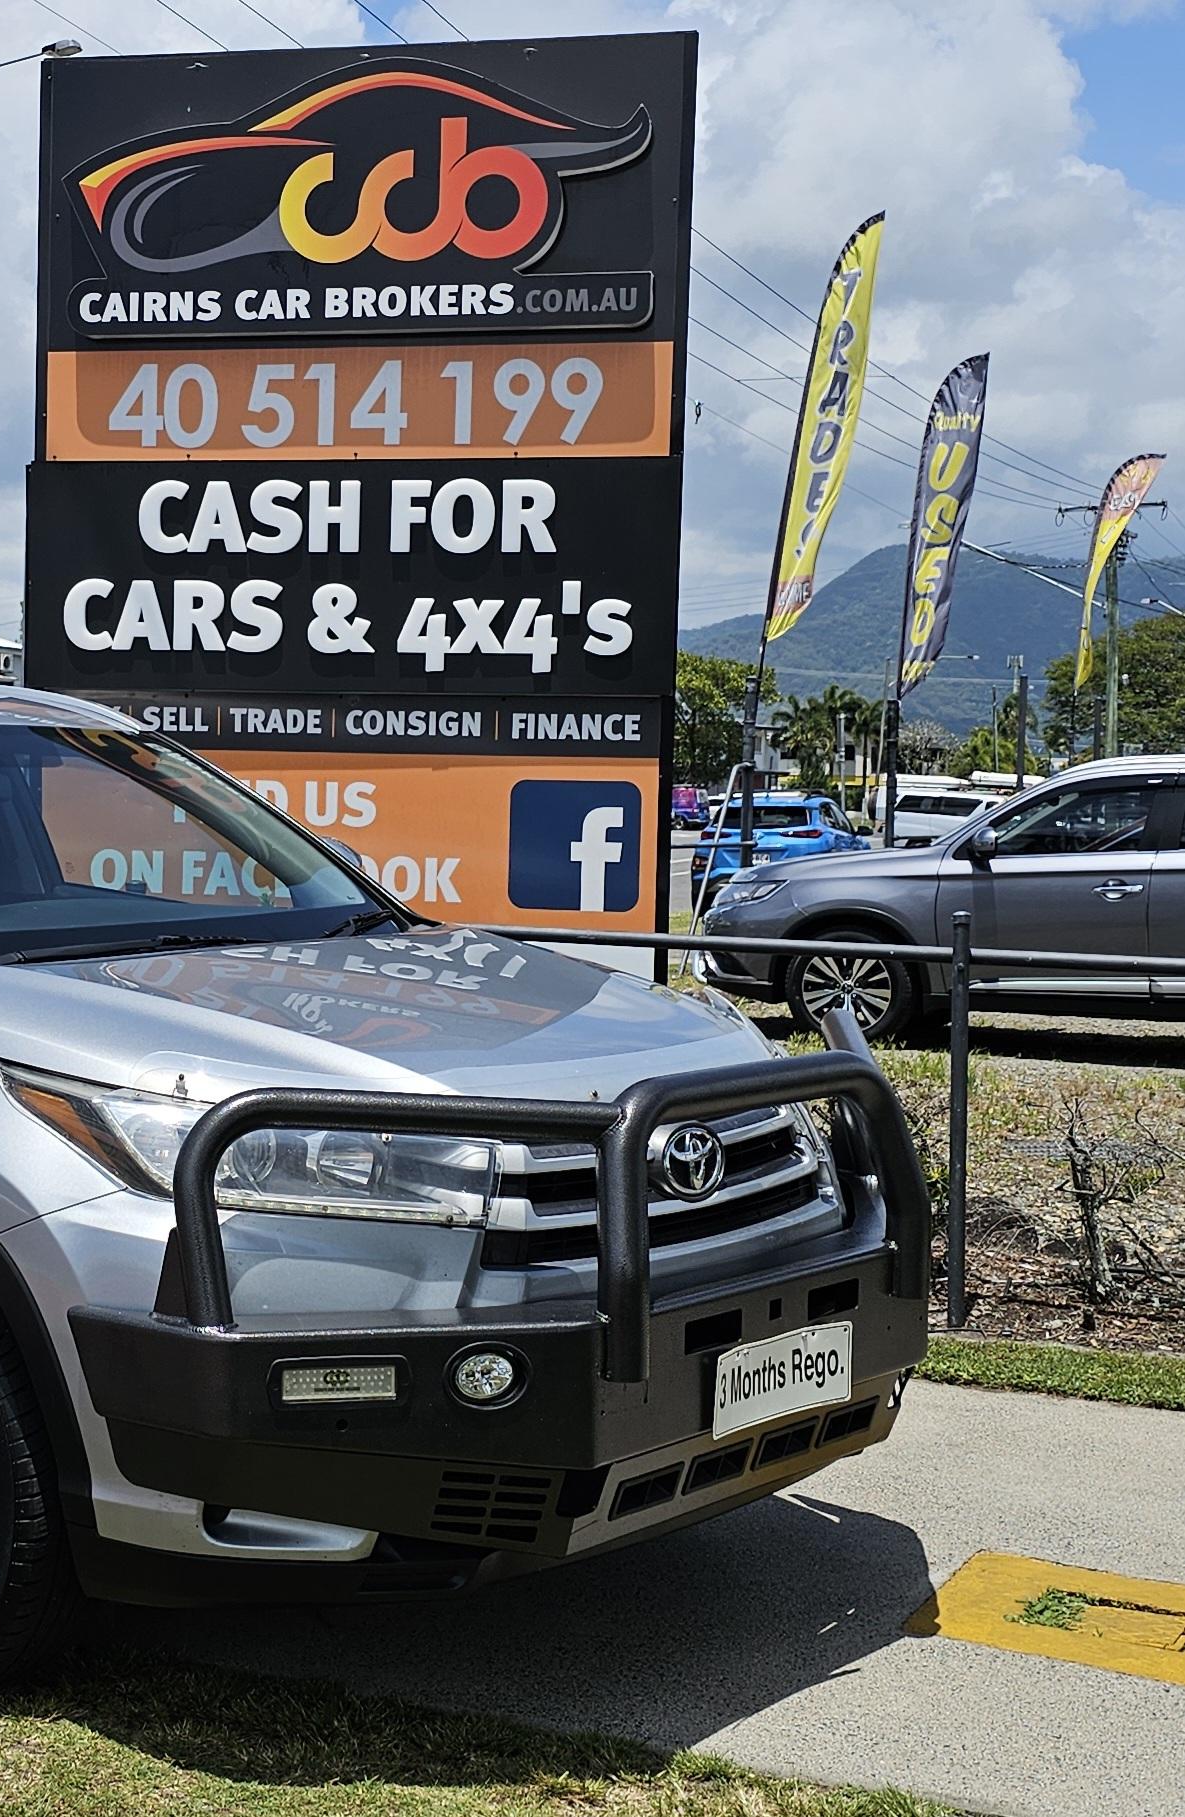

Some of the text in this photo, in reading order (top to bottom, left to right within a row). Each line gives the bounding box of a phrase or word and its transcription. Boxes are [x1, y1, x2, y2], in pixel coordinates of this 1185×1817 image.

[79, 291, 222, 323] CAIRNS
[234, 289, 311, 321] CAR
[108, 357, 604, 449] 40 514 199
[138, 477, 557, 554] CASH FOR
[909, 441, 970, 647] USED
[63, 578, 284, 653] CARS
[307, 582, 376, 654] &
[142, 705, 641, 741] SELL TRADE CONSIGN FINANCE
[305, 780, 377, 828] US
[90, 848, 164, 894] ON
[719, 1347, 845, 1409] 3 Months Rego.
